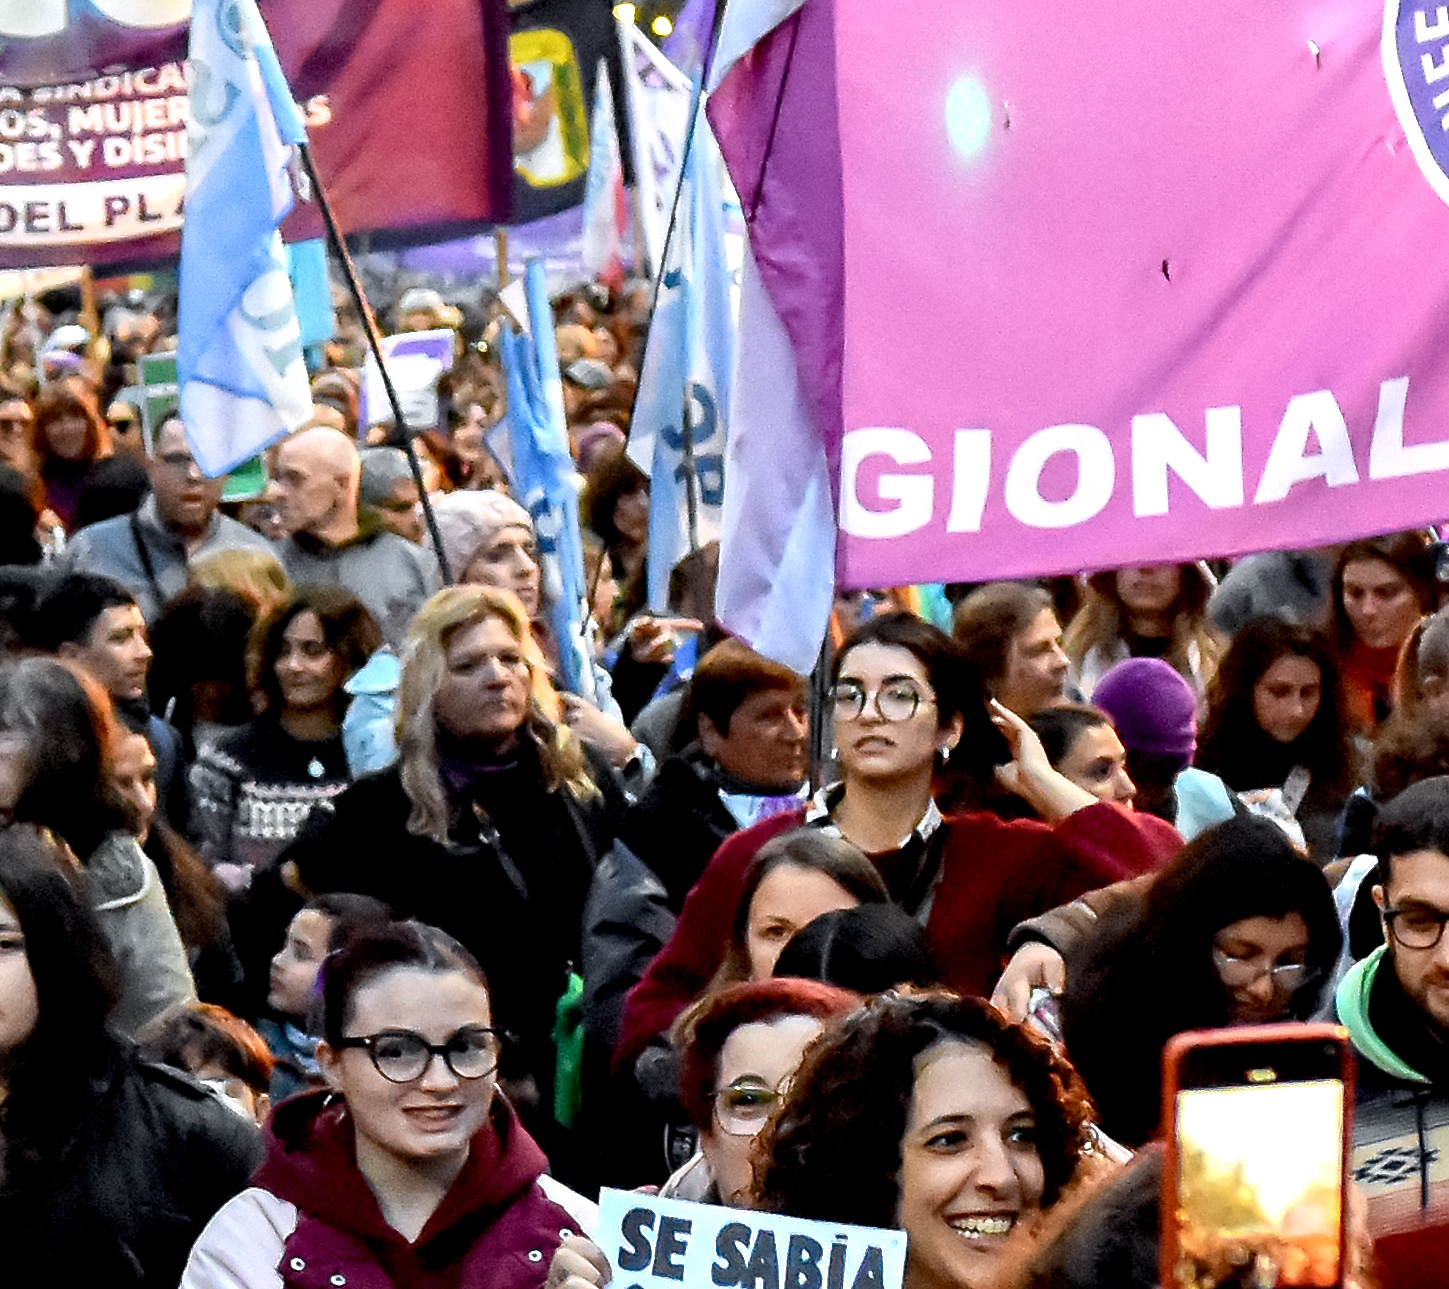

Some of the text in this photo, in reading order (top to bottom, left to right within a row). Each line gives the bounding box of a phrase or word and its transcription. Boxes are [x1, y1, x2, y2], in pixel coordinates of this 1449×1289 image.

[68, 96, 188, 134] MUJER
[68, 138, 94, 169] Y
[617, 1206, 693, 1282] SE
